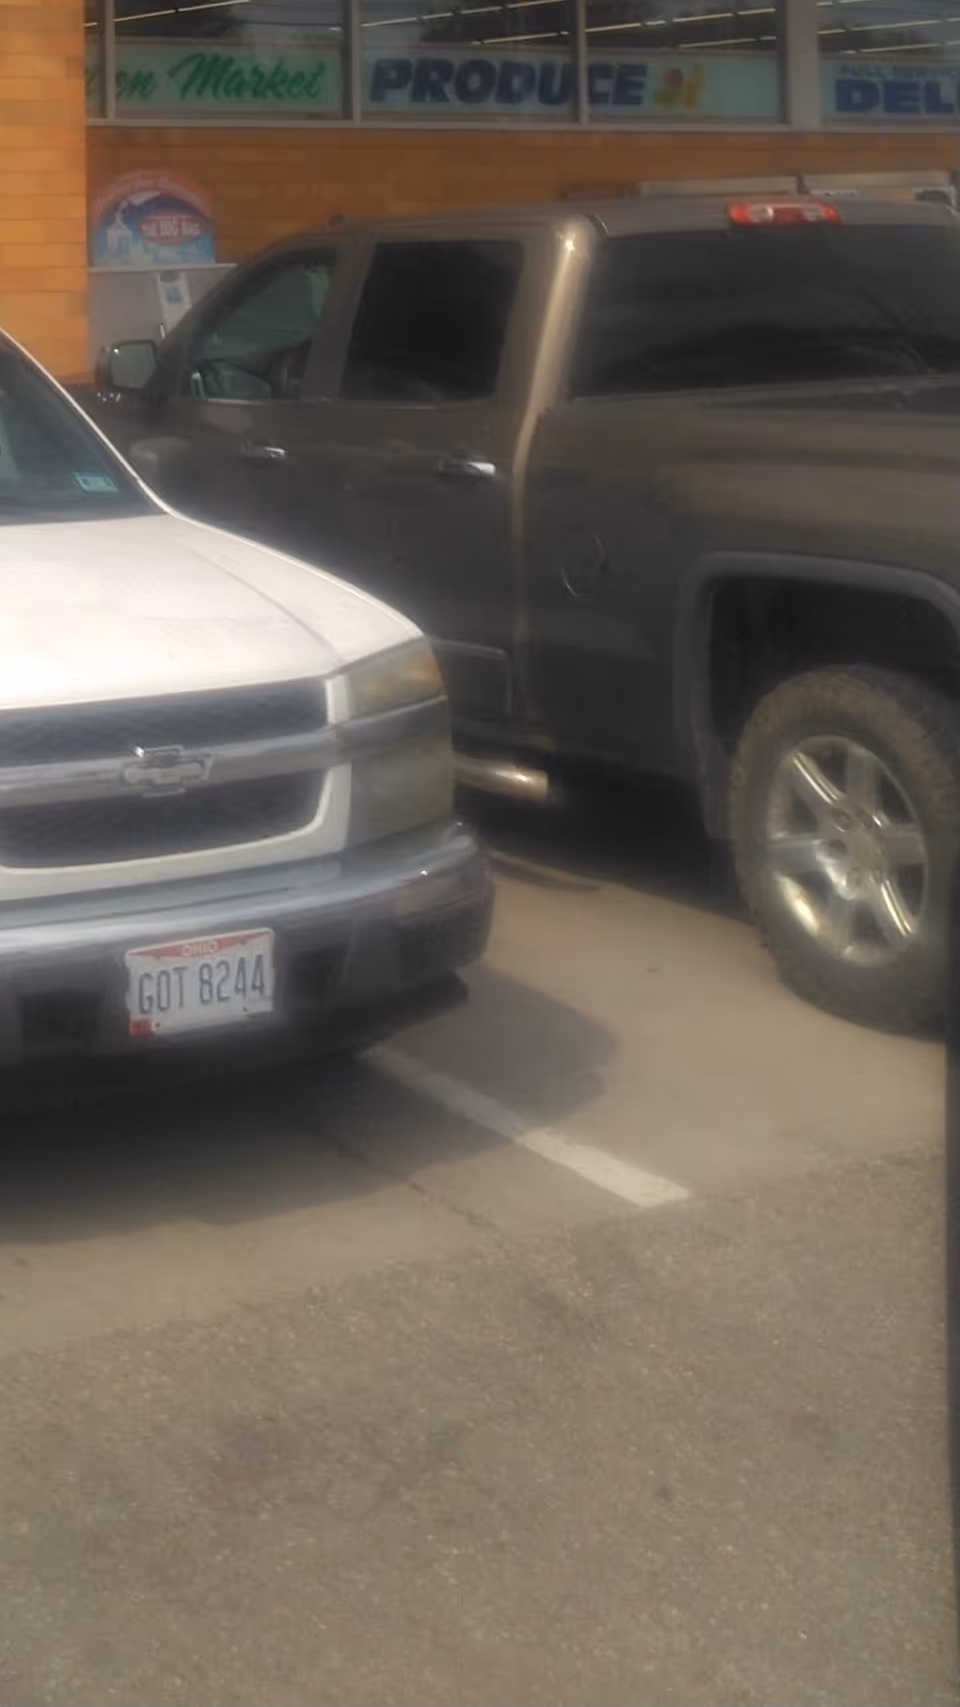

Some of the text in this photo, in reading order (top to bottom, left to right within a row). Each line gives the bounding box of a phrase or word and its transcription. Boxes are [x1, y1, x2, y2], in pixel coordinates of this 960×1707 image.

[166, 51, 329, 101] Market
[369, 58, 648, 106] PRODUCE
[834, 78, 960, 115] DEL
[138, 953, 265, 1015] GOT 8244
